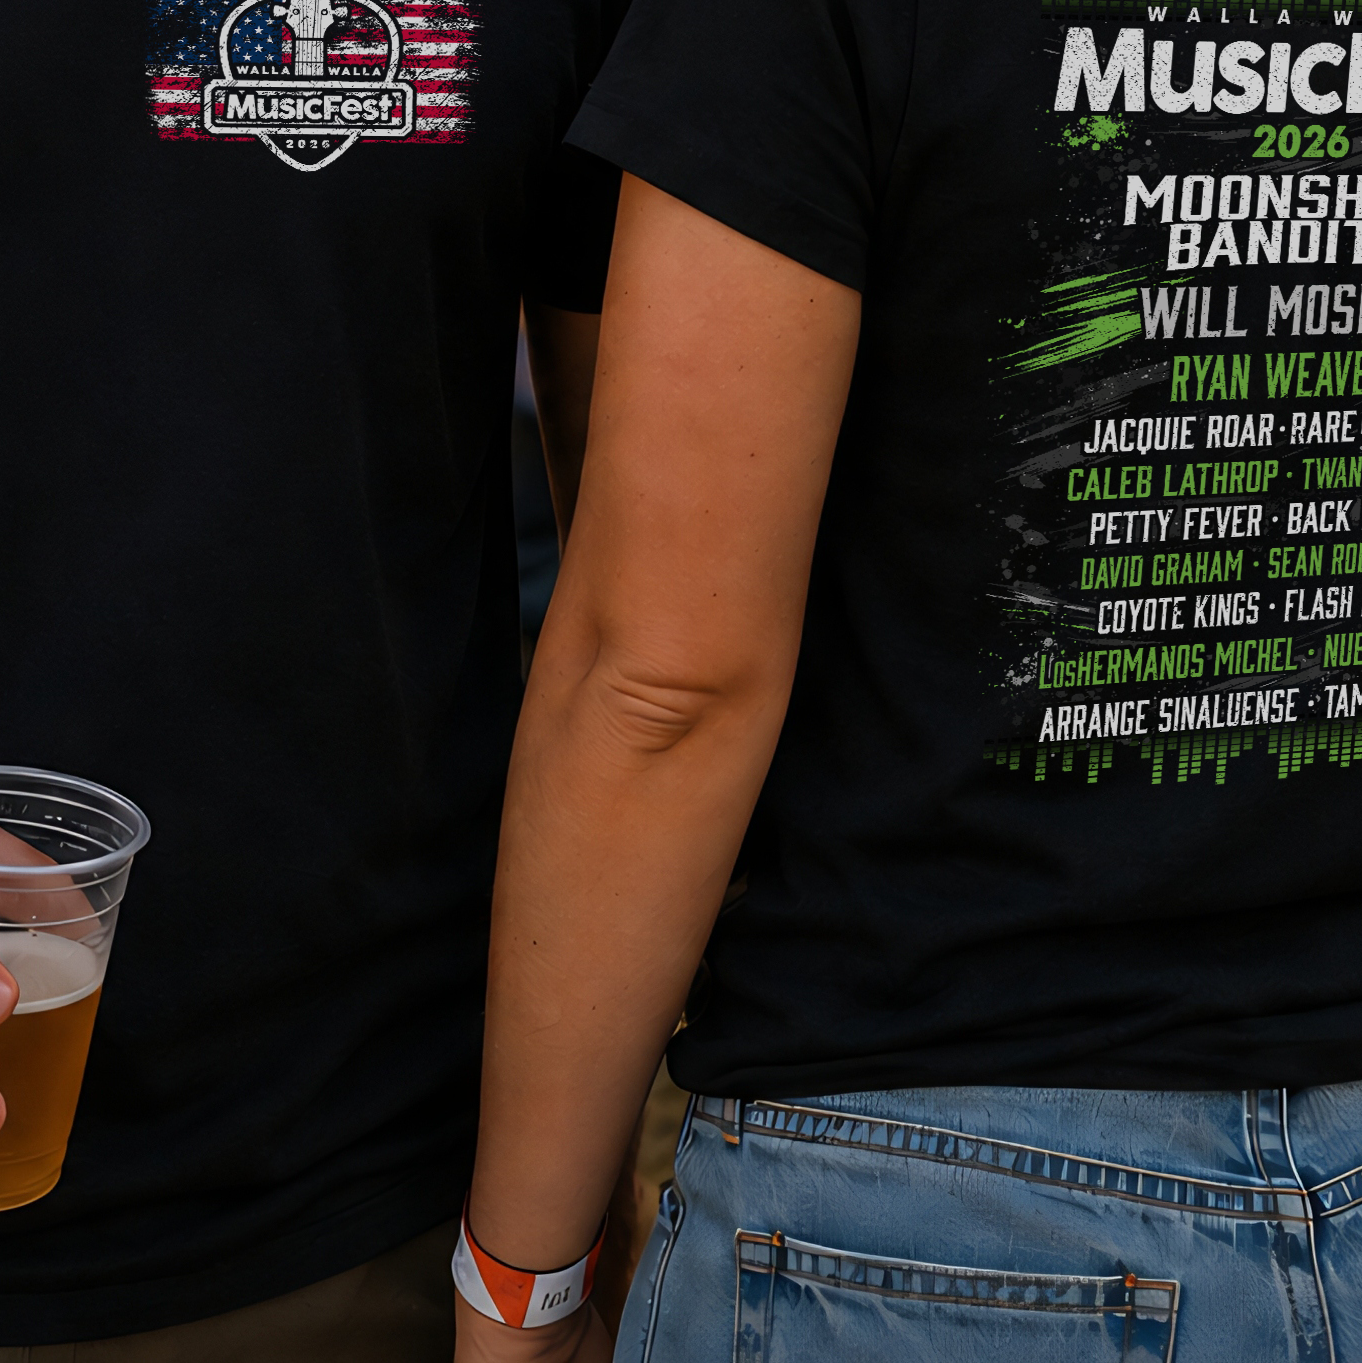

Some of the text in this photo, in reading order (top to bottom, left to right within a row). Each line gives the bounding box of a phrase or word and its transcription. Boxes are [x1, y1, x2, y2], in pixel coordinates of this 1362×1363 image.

[1147, 6, 1291, 25] WALLA
[237, 66, 382, 76] WALLA WALLA
[226, 94, 393, 121] MusicFest
[286, 140, 330, 149] 2026
[1251, 124, 1350, 159] 2026
[1140, 284, 1247, 341] WILL
[1170, 353, 1253, 403] RYAN
[1084, 416, 1197, 455] JACQUIE
[1205, 413, 1275, 449] ROAR
[1290, 410, 1358, 445] RARE
[1067, 465, 1153, 502] CALEB
[1162, 459, 1279, 497] LATHROP
[1089, 508, 1174, 546] PETTY
[1182, 504, 1263, 541] FEVER
[1287, 500, 1354, 535] BACK
[1080, 554, 1144, 591] DAVID
[1151, 549, 1244, 587] GRAHAM
[1267, 544, 1324, 579] SEAN
[1097, 596, 1187, 635] COYOTE
[1193, 591, 1261, 629] KINGS
[1283, 586, 1354, 623] FLASH
[1214, 637, 1299, 676] MICHEL
[1039, 699, 1150, 743] ARRANGE
[1157, 688, 1301, 734] SINALUENSE
